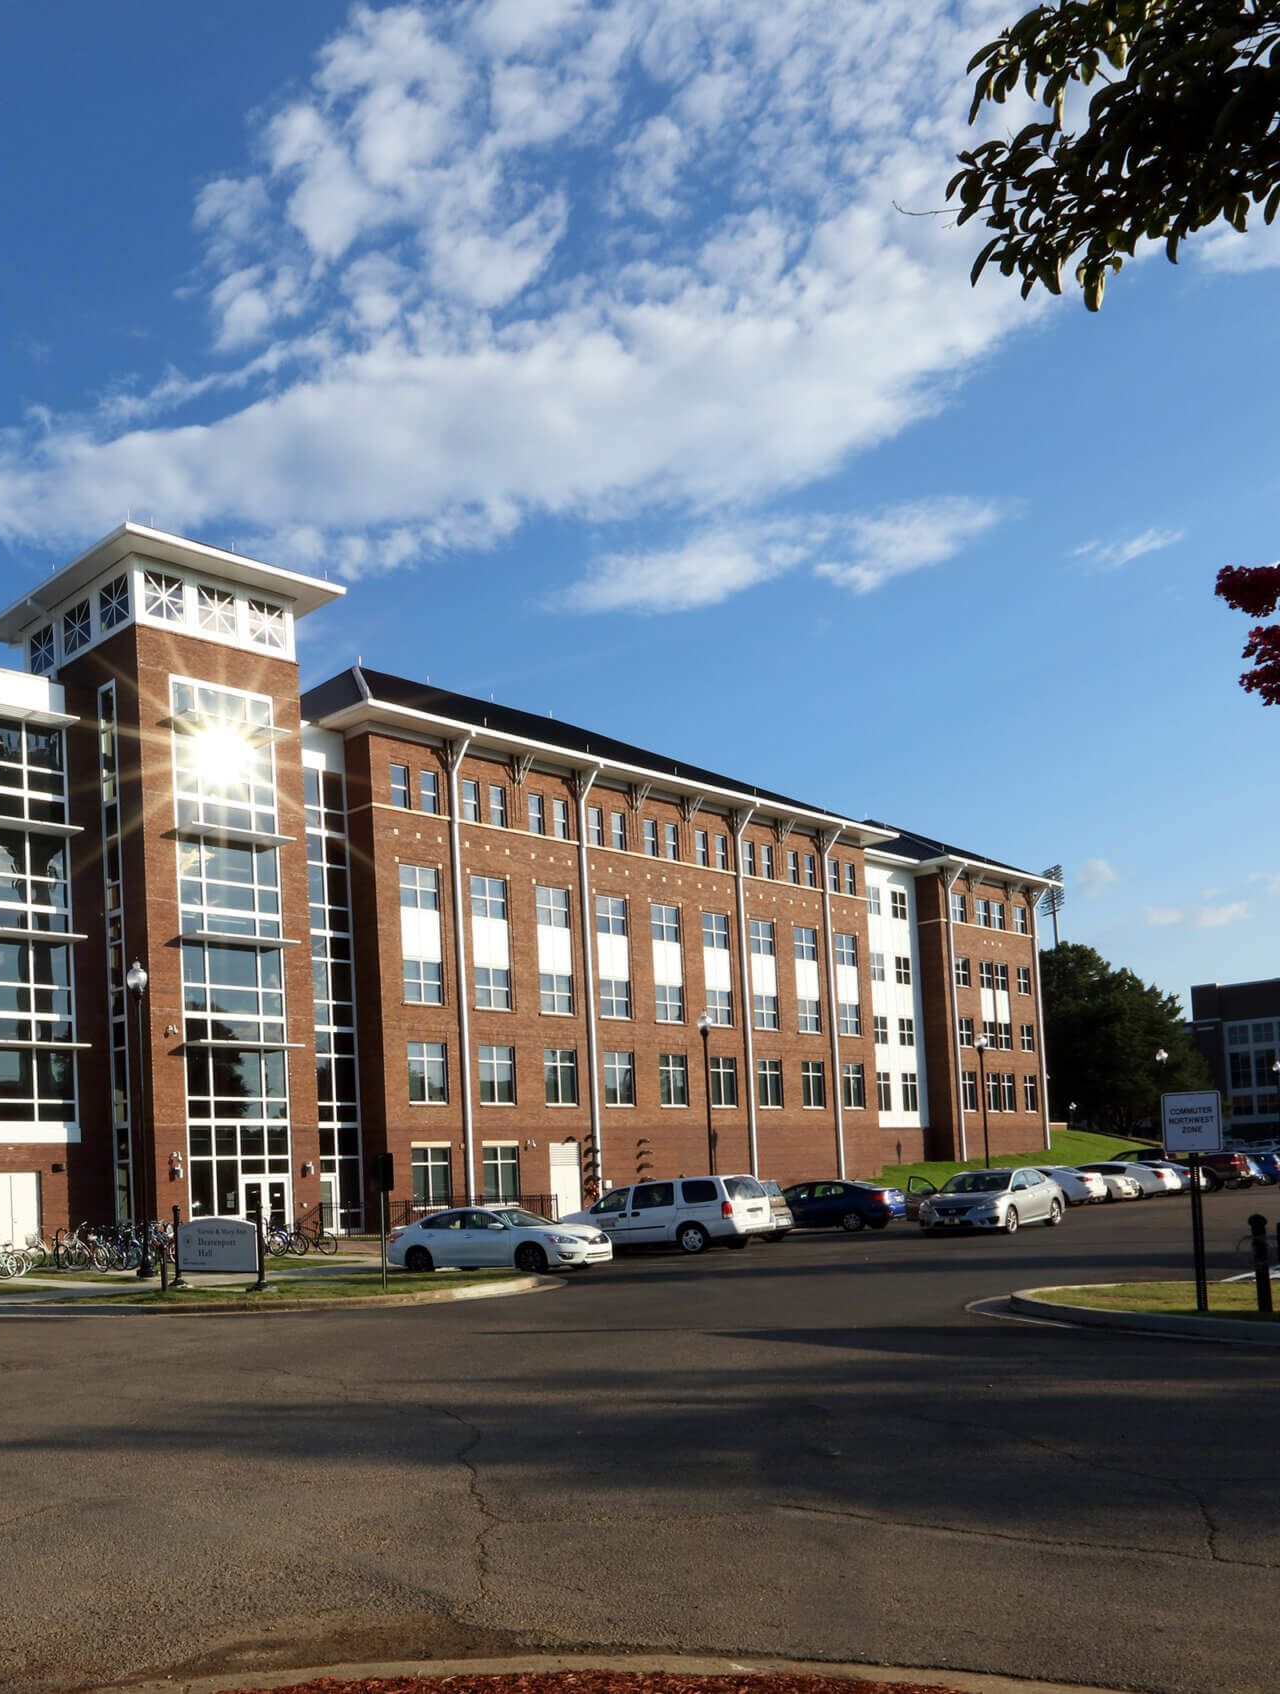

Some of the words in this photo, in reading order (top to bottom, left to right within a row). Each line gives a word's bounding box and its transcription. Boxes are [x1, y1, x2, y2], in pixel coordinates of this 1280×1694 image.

[1170, 1106, 1212, 1115] COMMUTER
[1169, 1115, 1213, 1124] NORTHWEST
[1182, 1126, 1202, 1134] ZONE
[198, 1237, 236, 1248] Davenport
[198, 1249, 213, 1257] Hall
